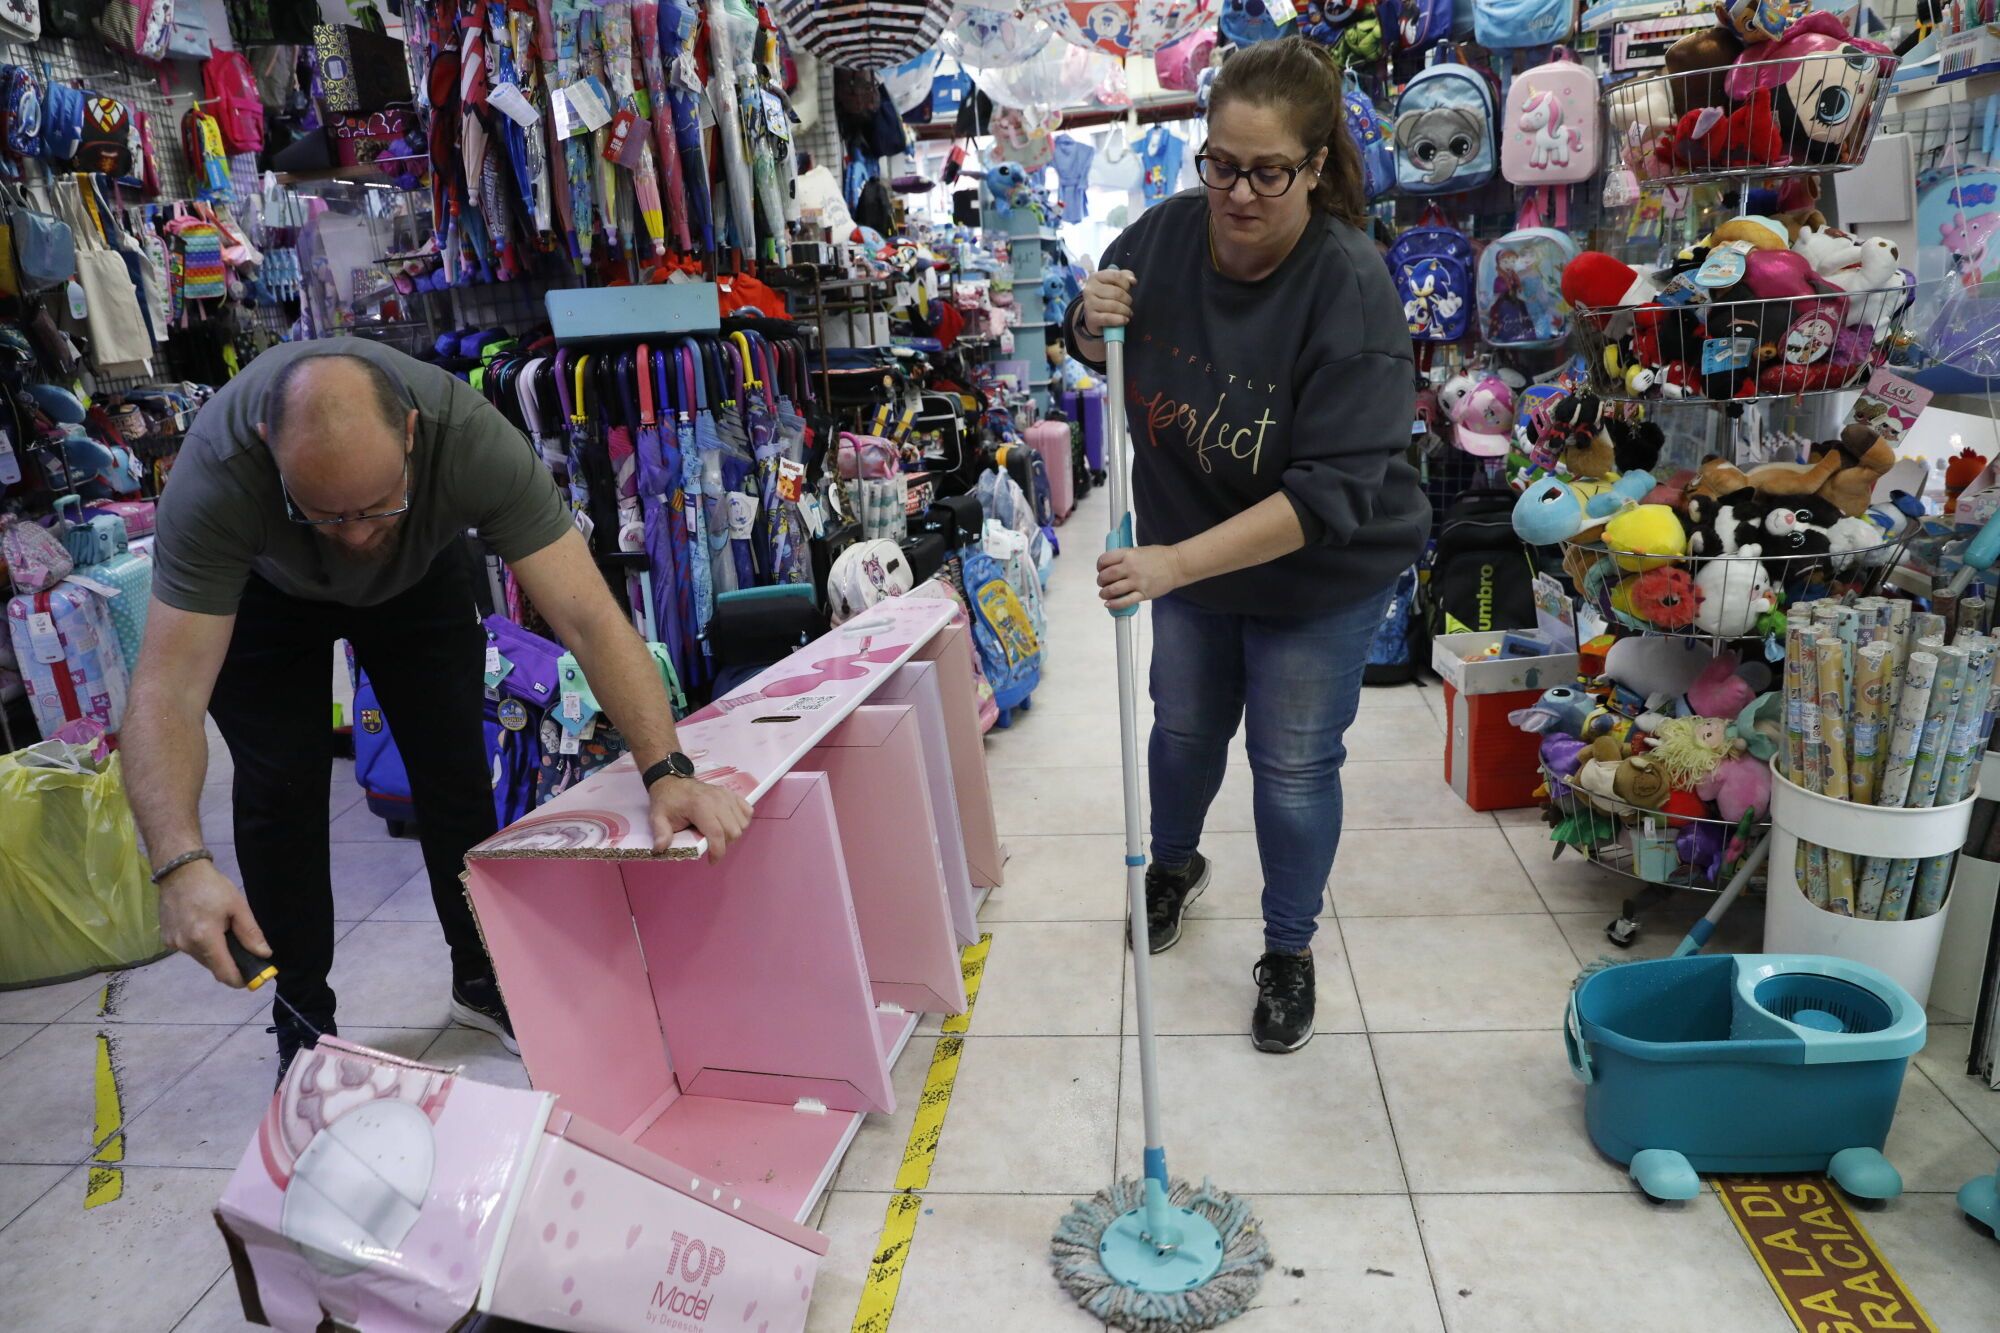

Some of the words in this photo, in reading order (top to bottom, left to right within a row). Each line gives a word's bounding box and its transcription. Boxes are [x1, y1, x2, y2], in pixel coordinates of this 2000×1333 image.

[1143, 333, 1276, 394] PRFETLY
[1475, 564, 1493, 631] umbro
[1731, 1176, 1786, 1217] DI
[666, 1231, 726, 1287] TOP
[1762, 1228, 1825, 1277] LA
[646, 1310, 657, 1324] by
[651, 1281, 714, 1321] Model
